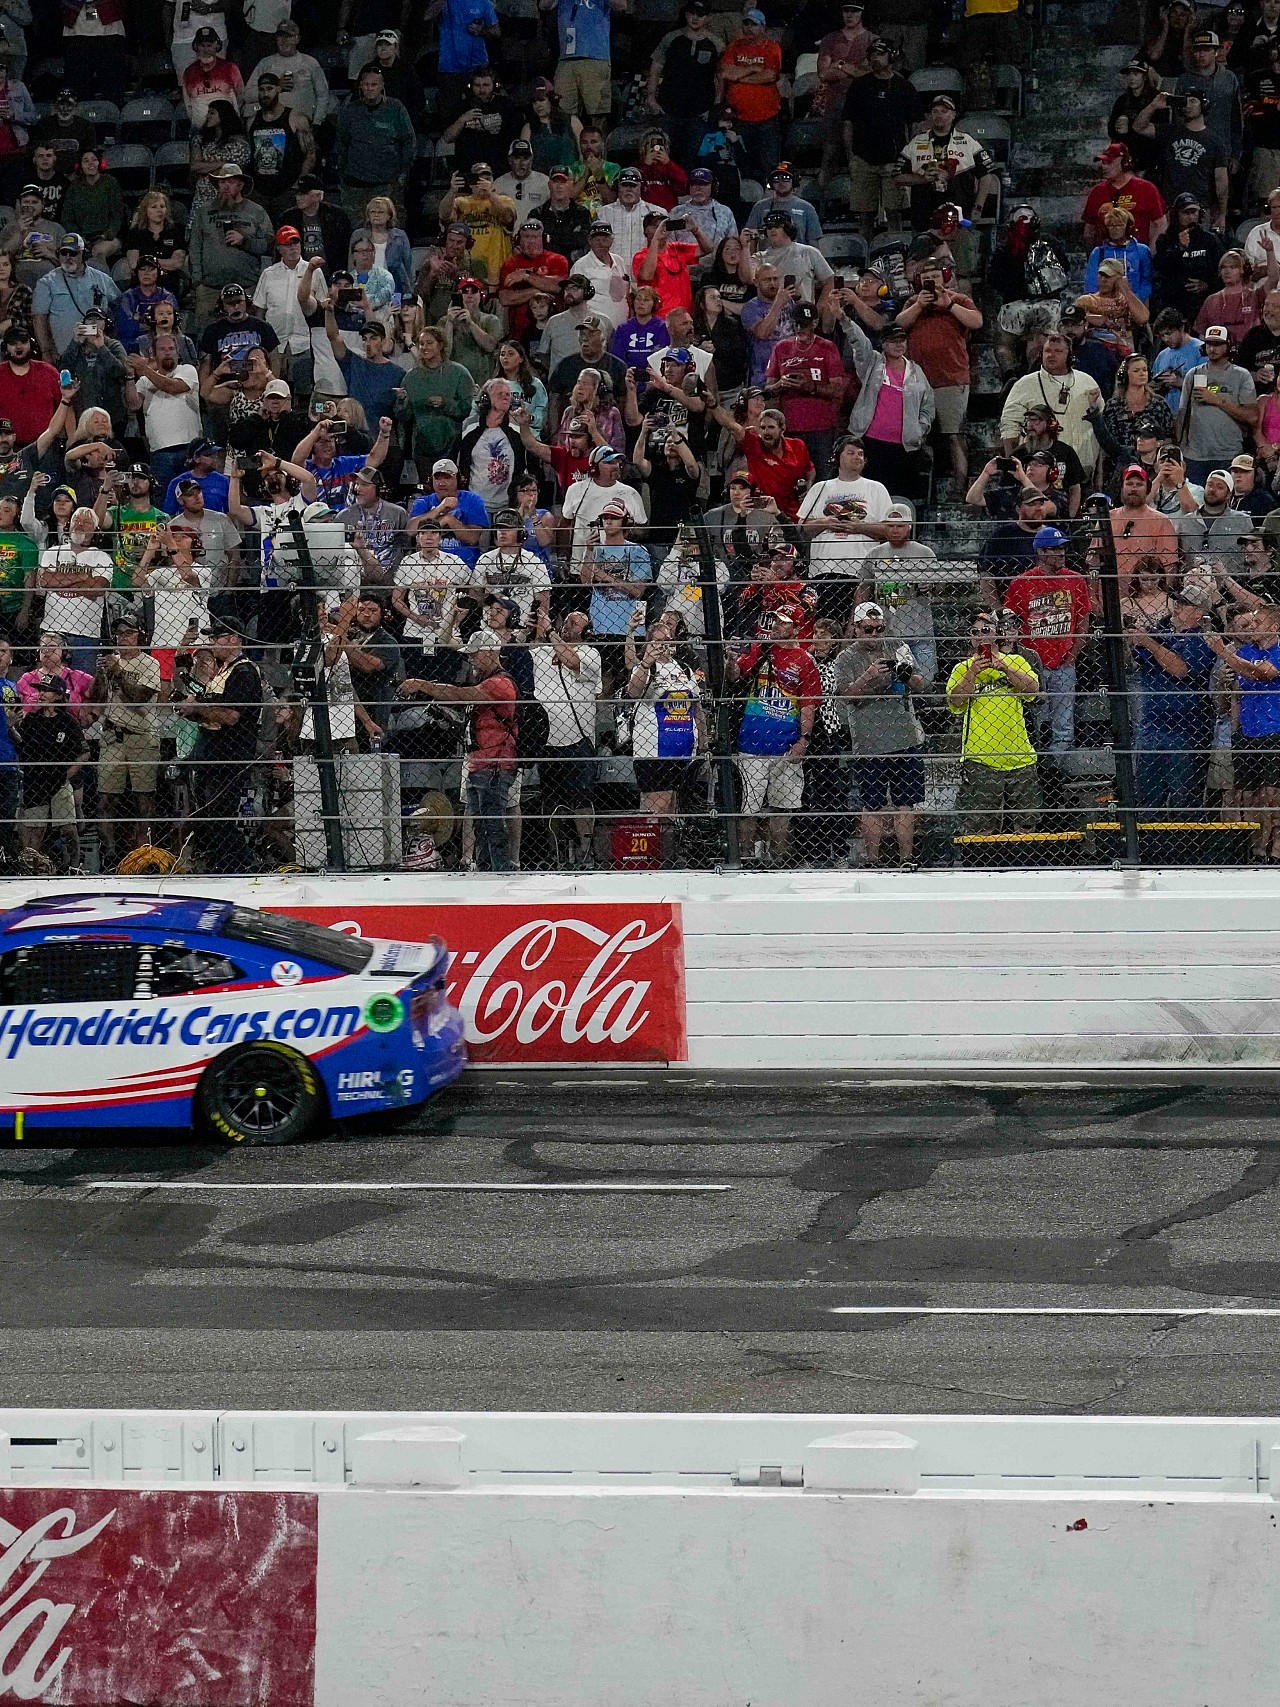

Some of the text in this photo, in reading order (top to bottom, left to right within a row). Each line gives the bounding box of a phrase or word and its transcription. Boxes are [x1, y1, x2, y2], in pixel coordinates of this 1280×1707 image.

[1118, 195, 1133, 203] 22
[810, 368, 822, 381] 8
[56, 732, 66, 743] 9
[631, 838, 648, 852] 20
[337, 1070, 414, 1089] HIRG
